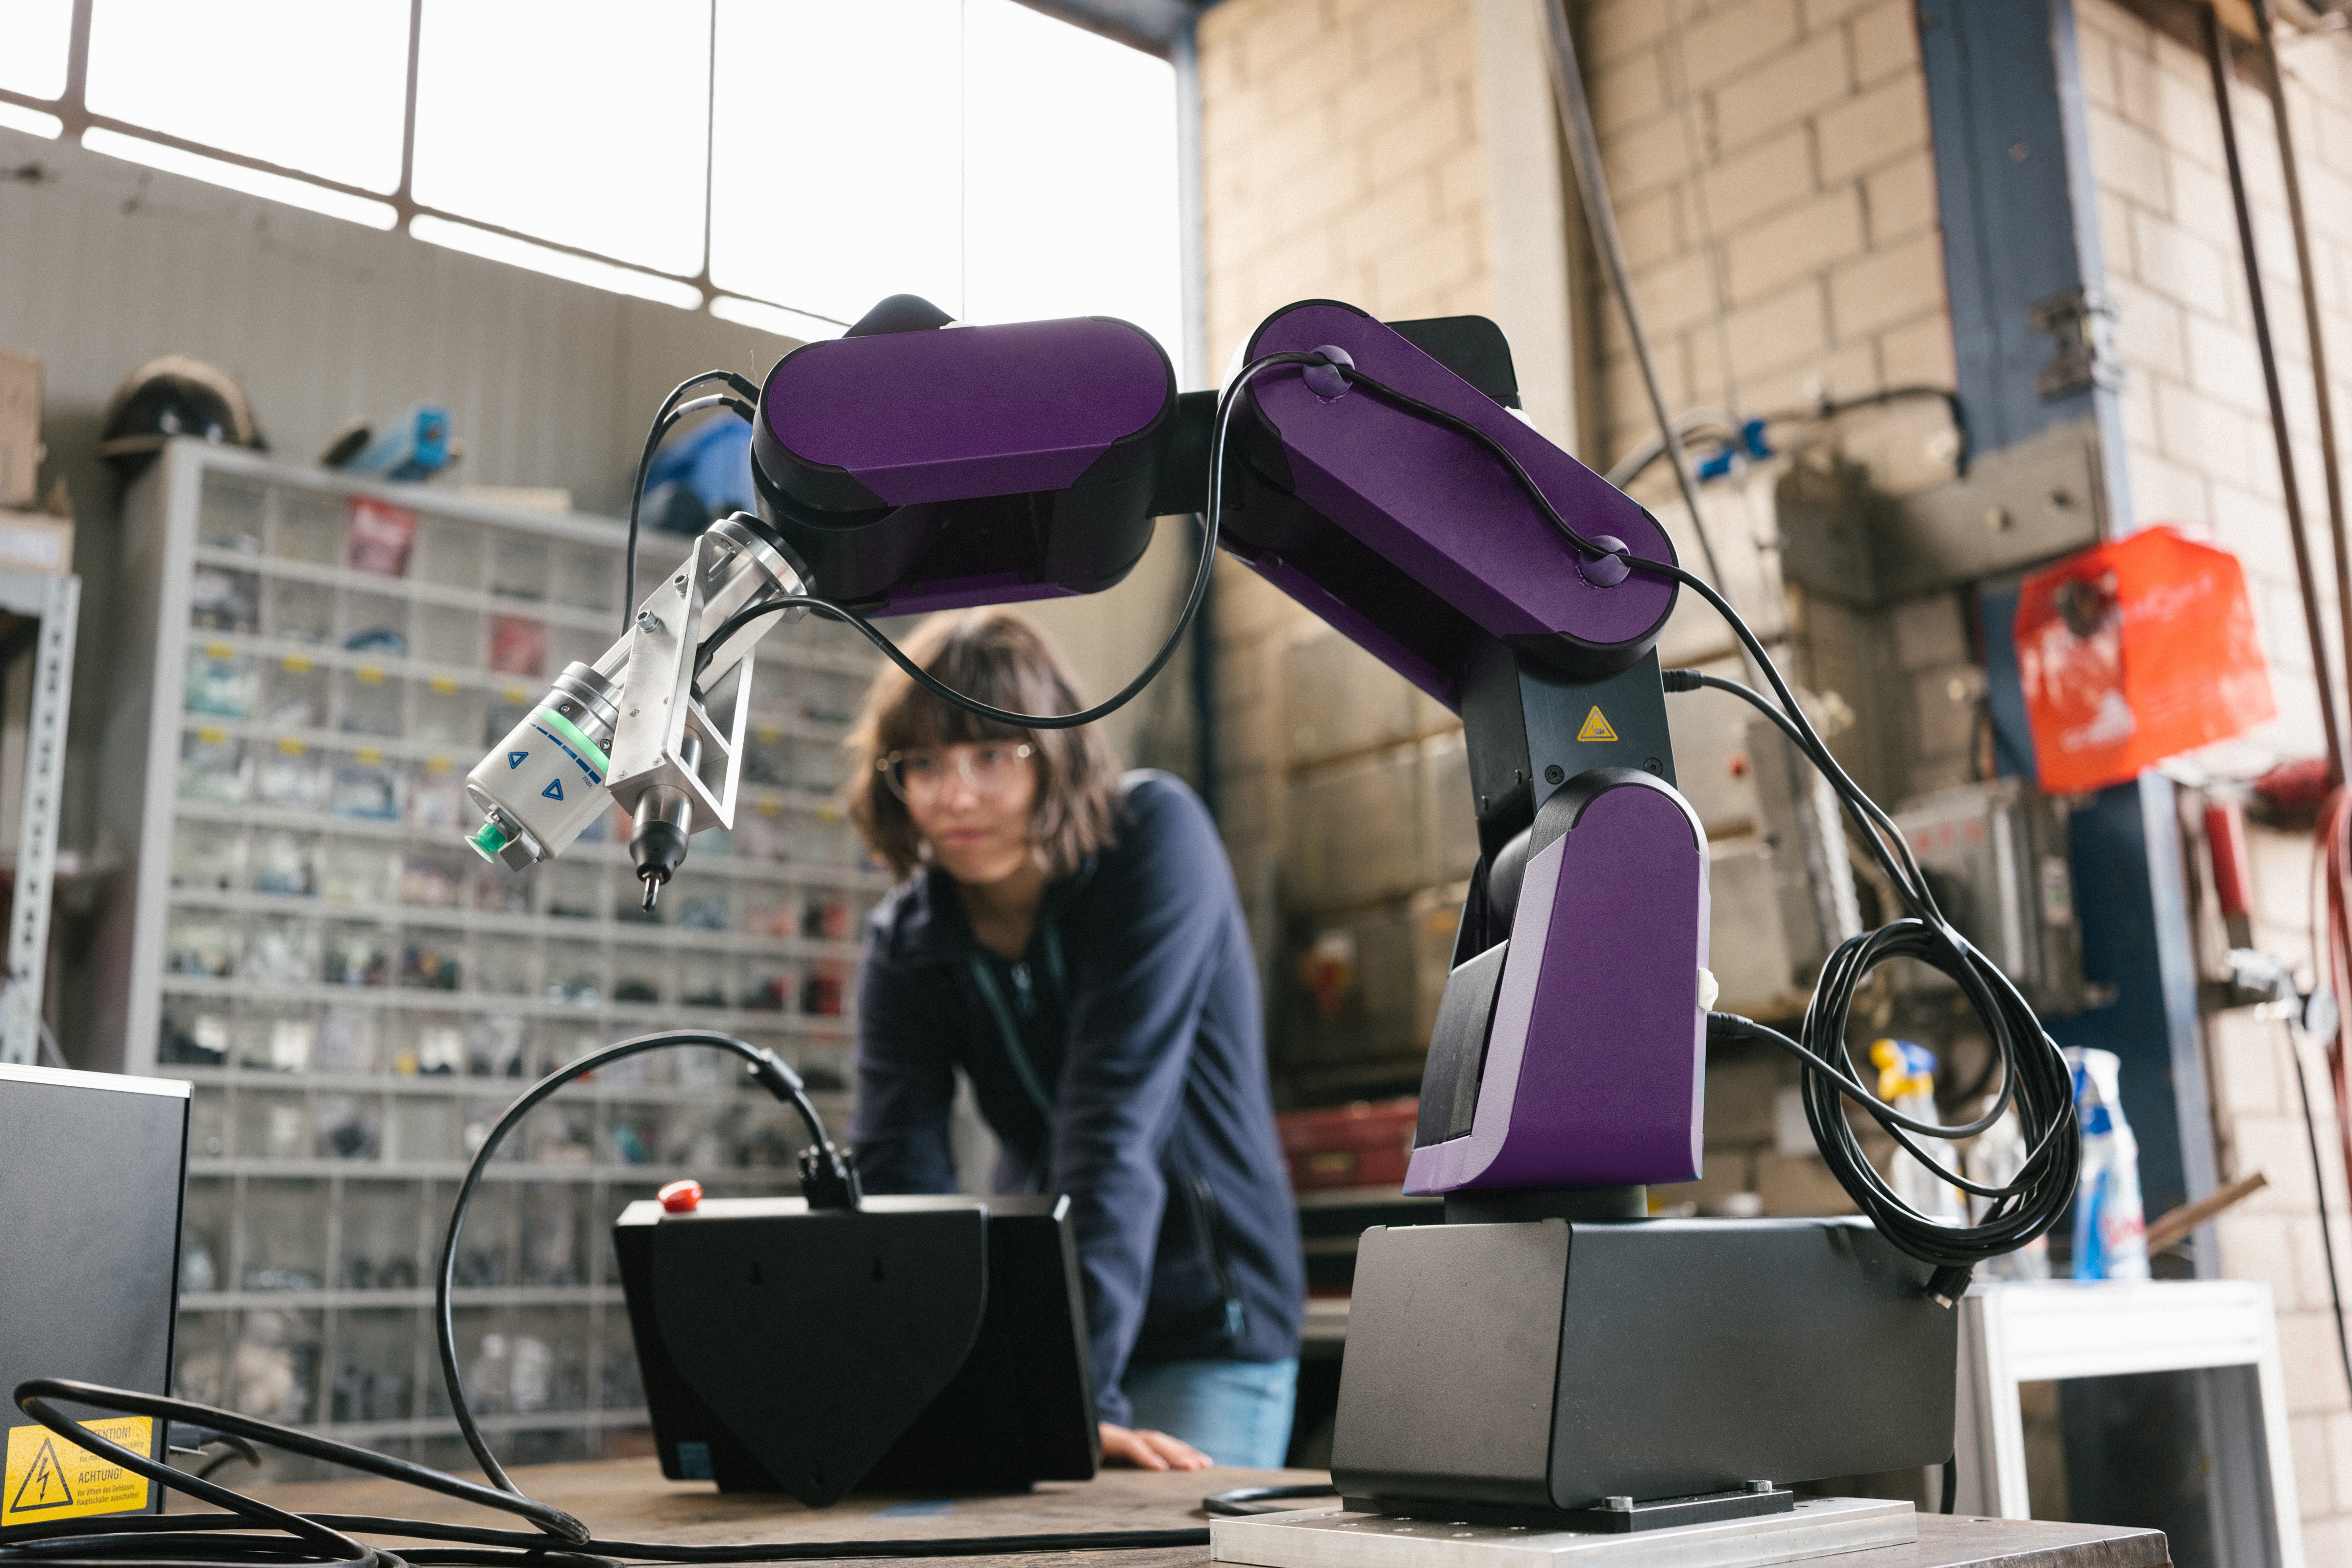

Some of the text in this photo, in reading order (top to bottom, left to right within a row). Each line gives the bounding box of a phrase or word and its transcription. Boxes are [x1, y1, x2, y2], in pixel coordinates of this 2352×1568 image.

[582, 776, 593, 790] max.
[78, 1468, 122, 1484] ACHTUNG!
[112, 1484, 135, 1493] Gehäuses
[76, 1491, 140, 1506] Hauptschalter ausschalten!
